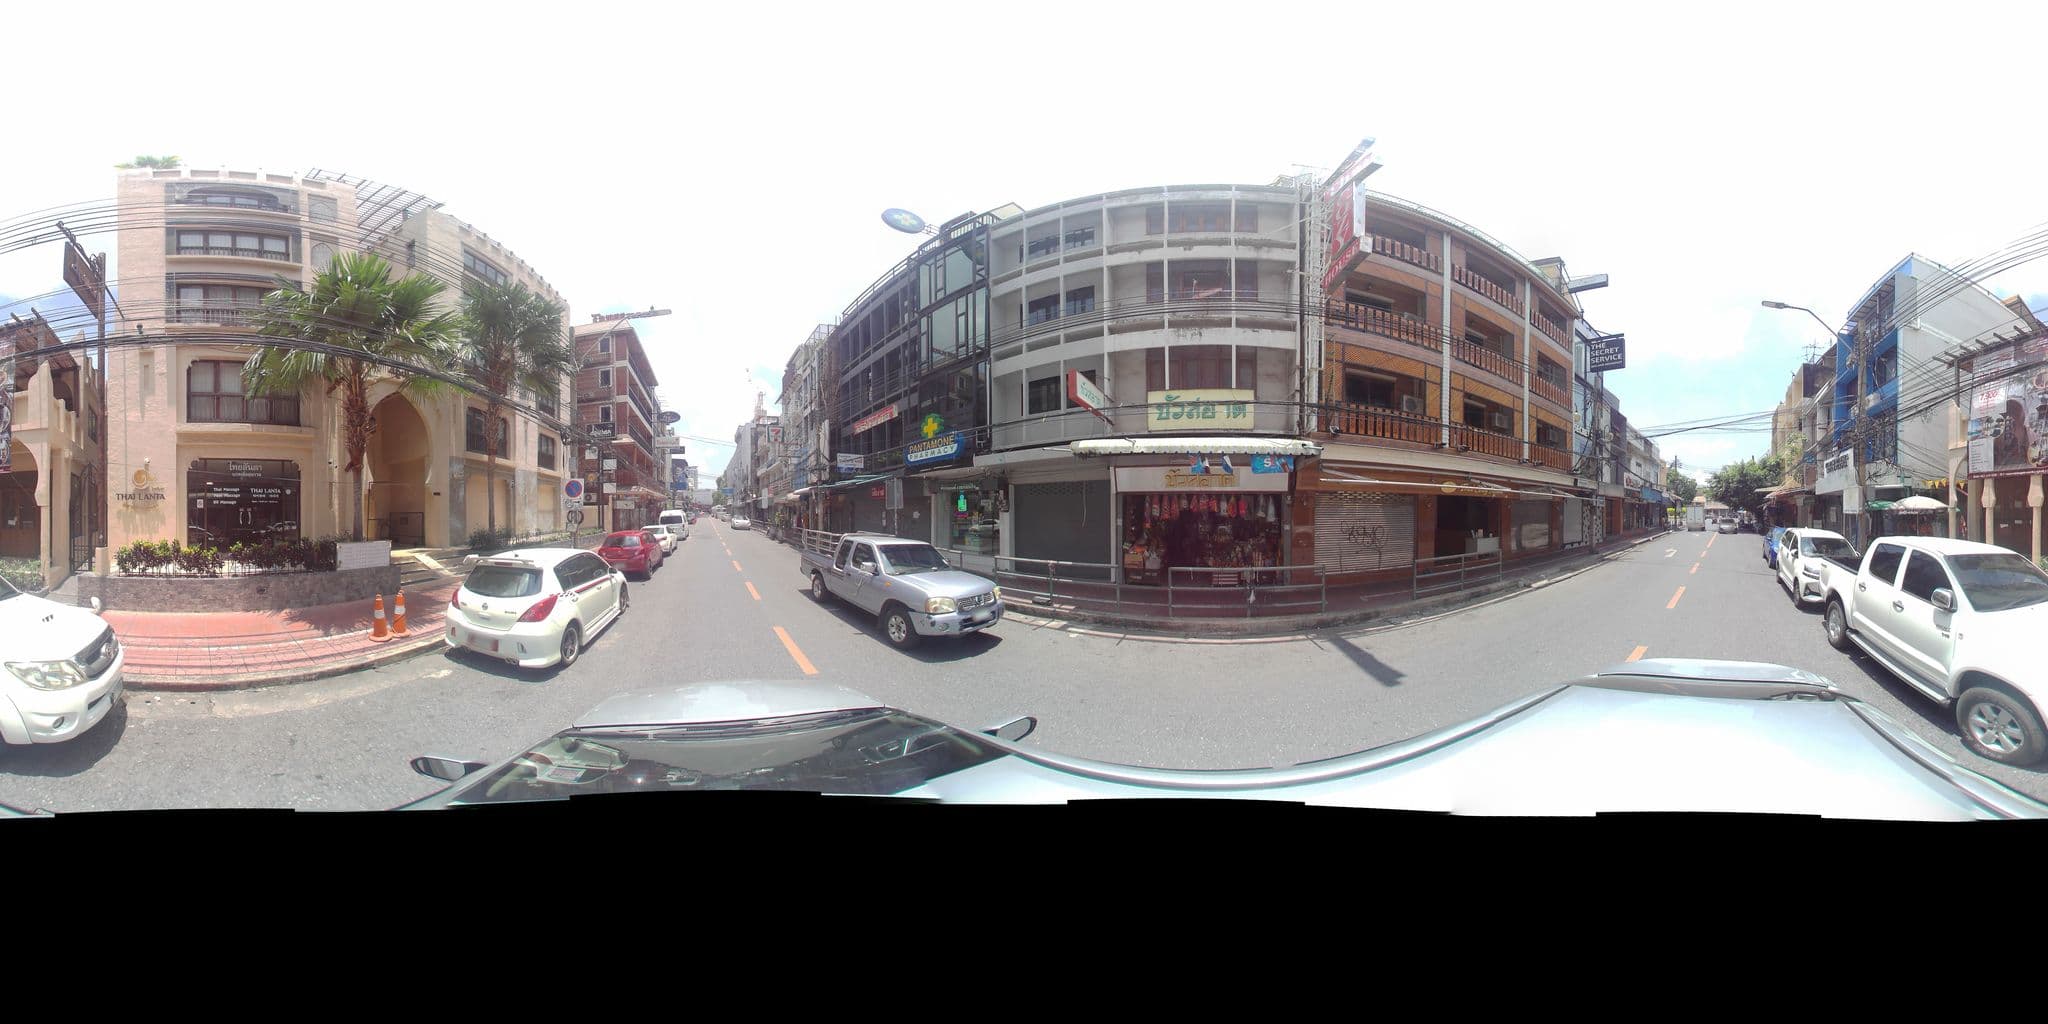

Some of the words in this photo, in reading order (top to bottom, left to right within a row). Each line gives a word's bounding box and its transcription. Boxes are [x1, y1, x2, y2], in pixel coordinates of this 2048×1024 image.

[1325, 239, 1360, 286] HOUSE
[1591, 347, 1620, 357] SECRET
[1591, 354, 1623, 364] SERVICE
[908, 434, 955, 454] PANTAMONE
[909, 446, 955, 460] PHARMACY
